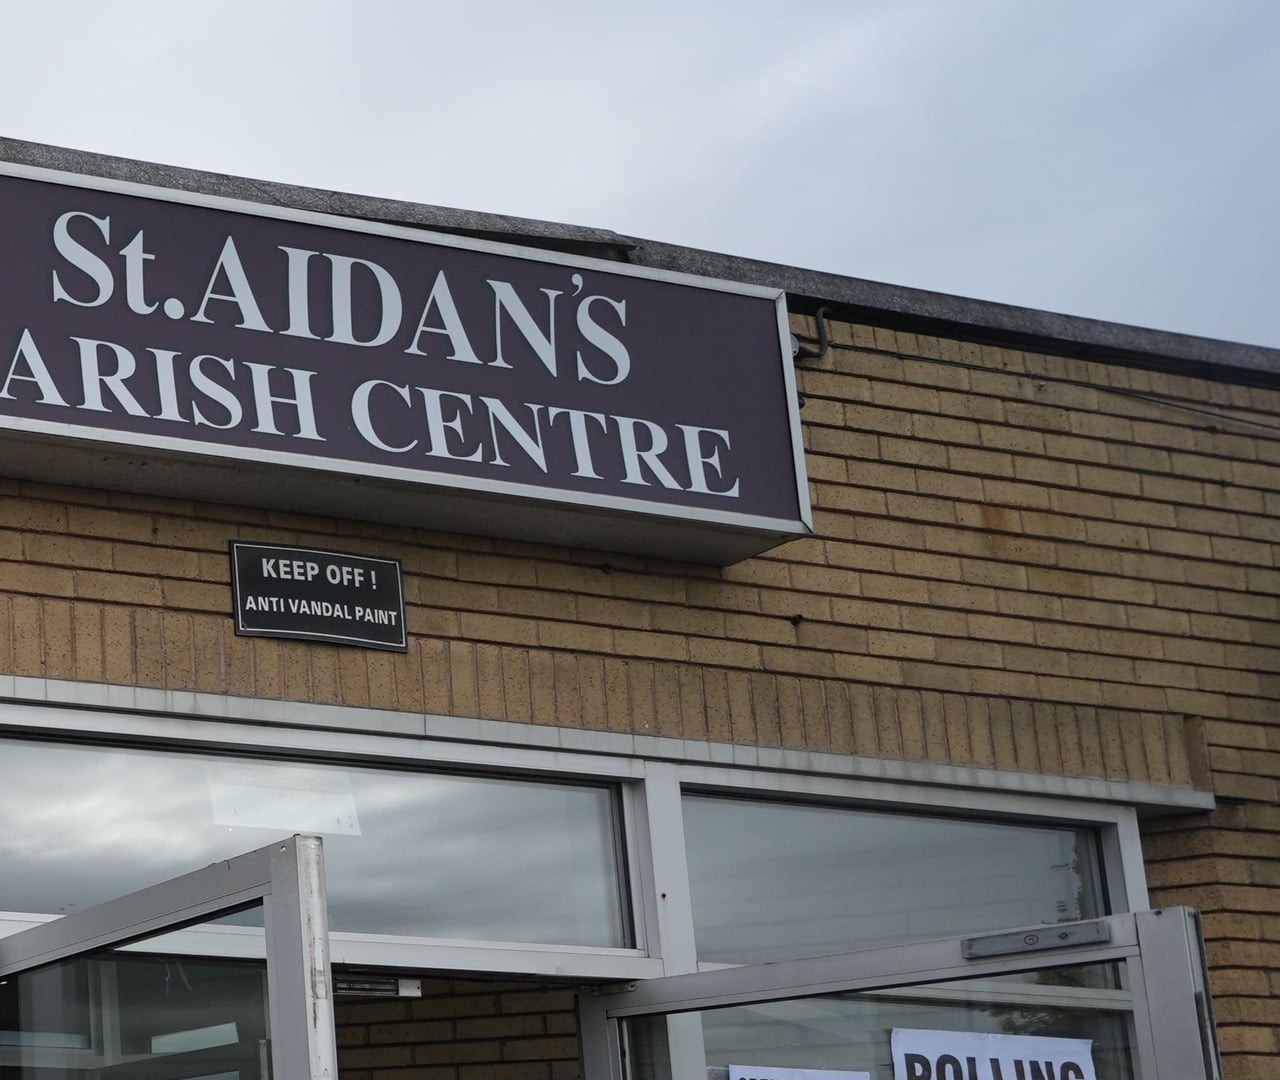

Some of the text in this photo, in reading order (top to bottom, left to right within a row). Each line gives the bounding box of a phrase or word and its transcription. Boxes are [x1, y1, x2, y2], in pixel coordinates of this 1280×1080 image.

[51, 210, 633, 387] St.AIDAN'S
[350, 378, 740, 499] CENTRE
[261, 557, 319, 582] KEEP
[326, 564, 364, 588] OFF
[245, 595, 397, 627] ANTI VANDAL PAINT
